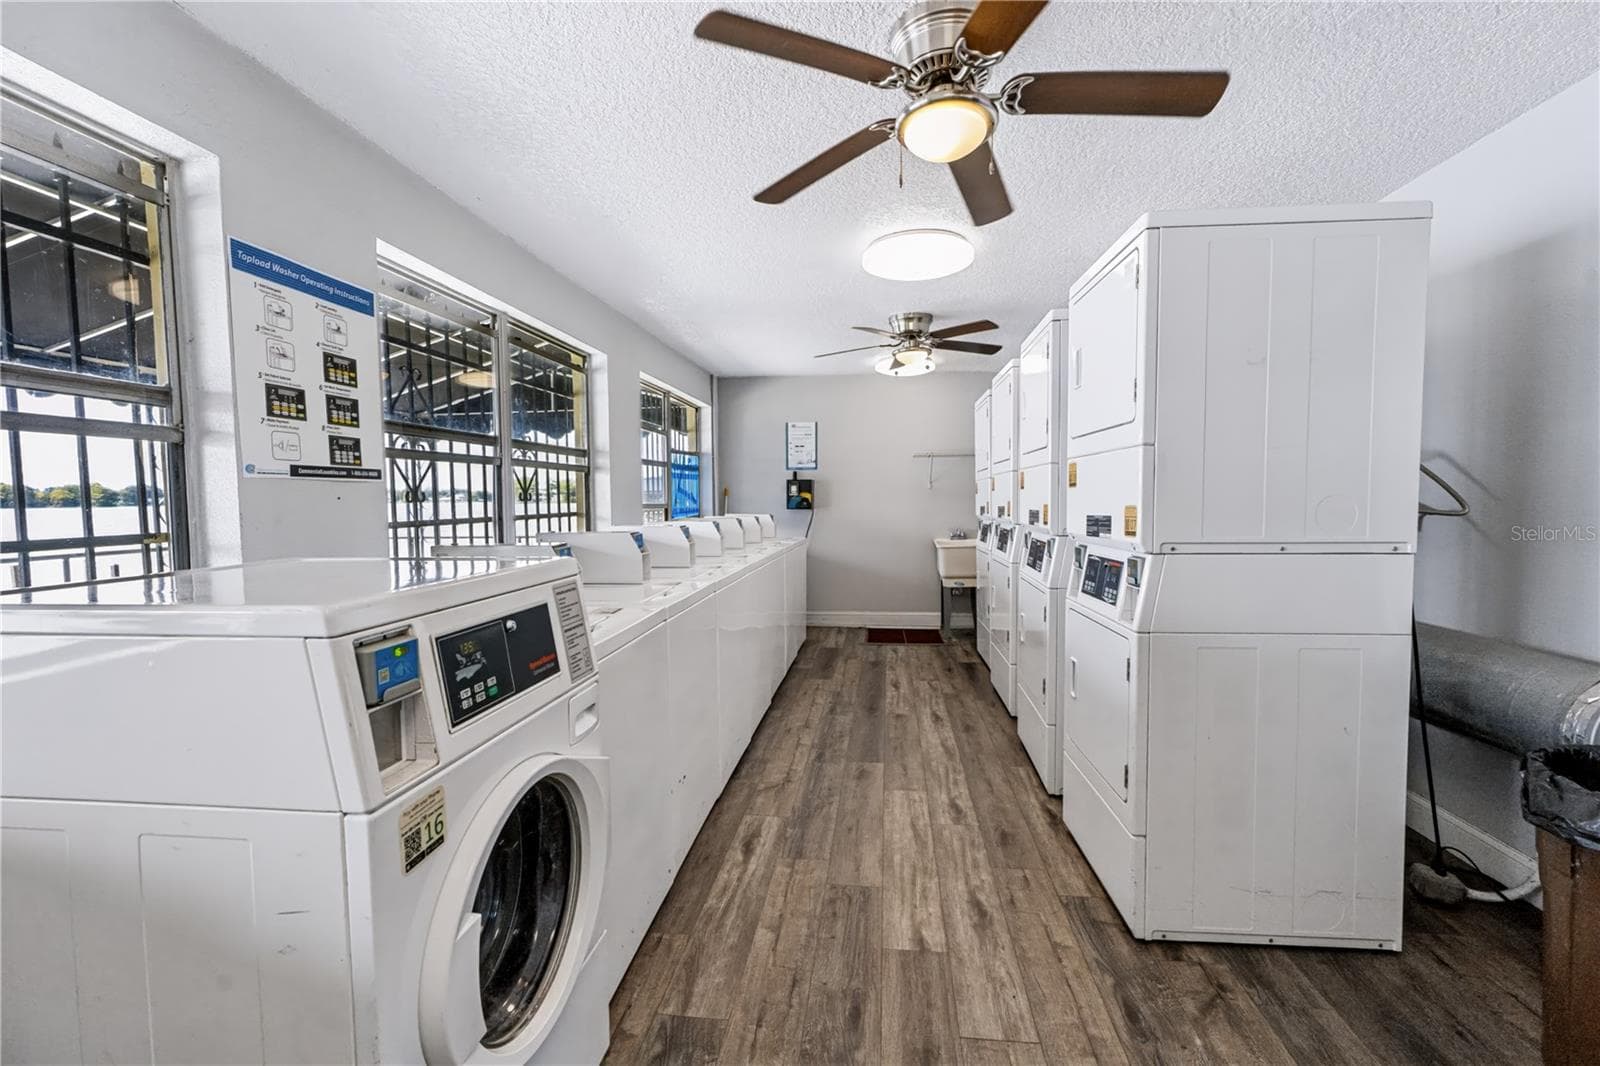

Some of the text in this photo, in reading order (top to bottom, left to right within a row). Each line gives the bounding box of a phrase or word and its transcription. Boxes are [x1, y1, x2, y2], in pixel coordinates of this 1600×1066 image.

[237, 250, 271, 269] Topload
[272, 263, 299, 280] Washer
[301, 274, 334, 295] Operating
[335, 287, 370, 306] Instructions
[424, 812, 444, 844] 16
